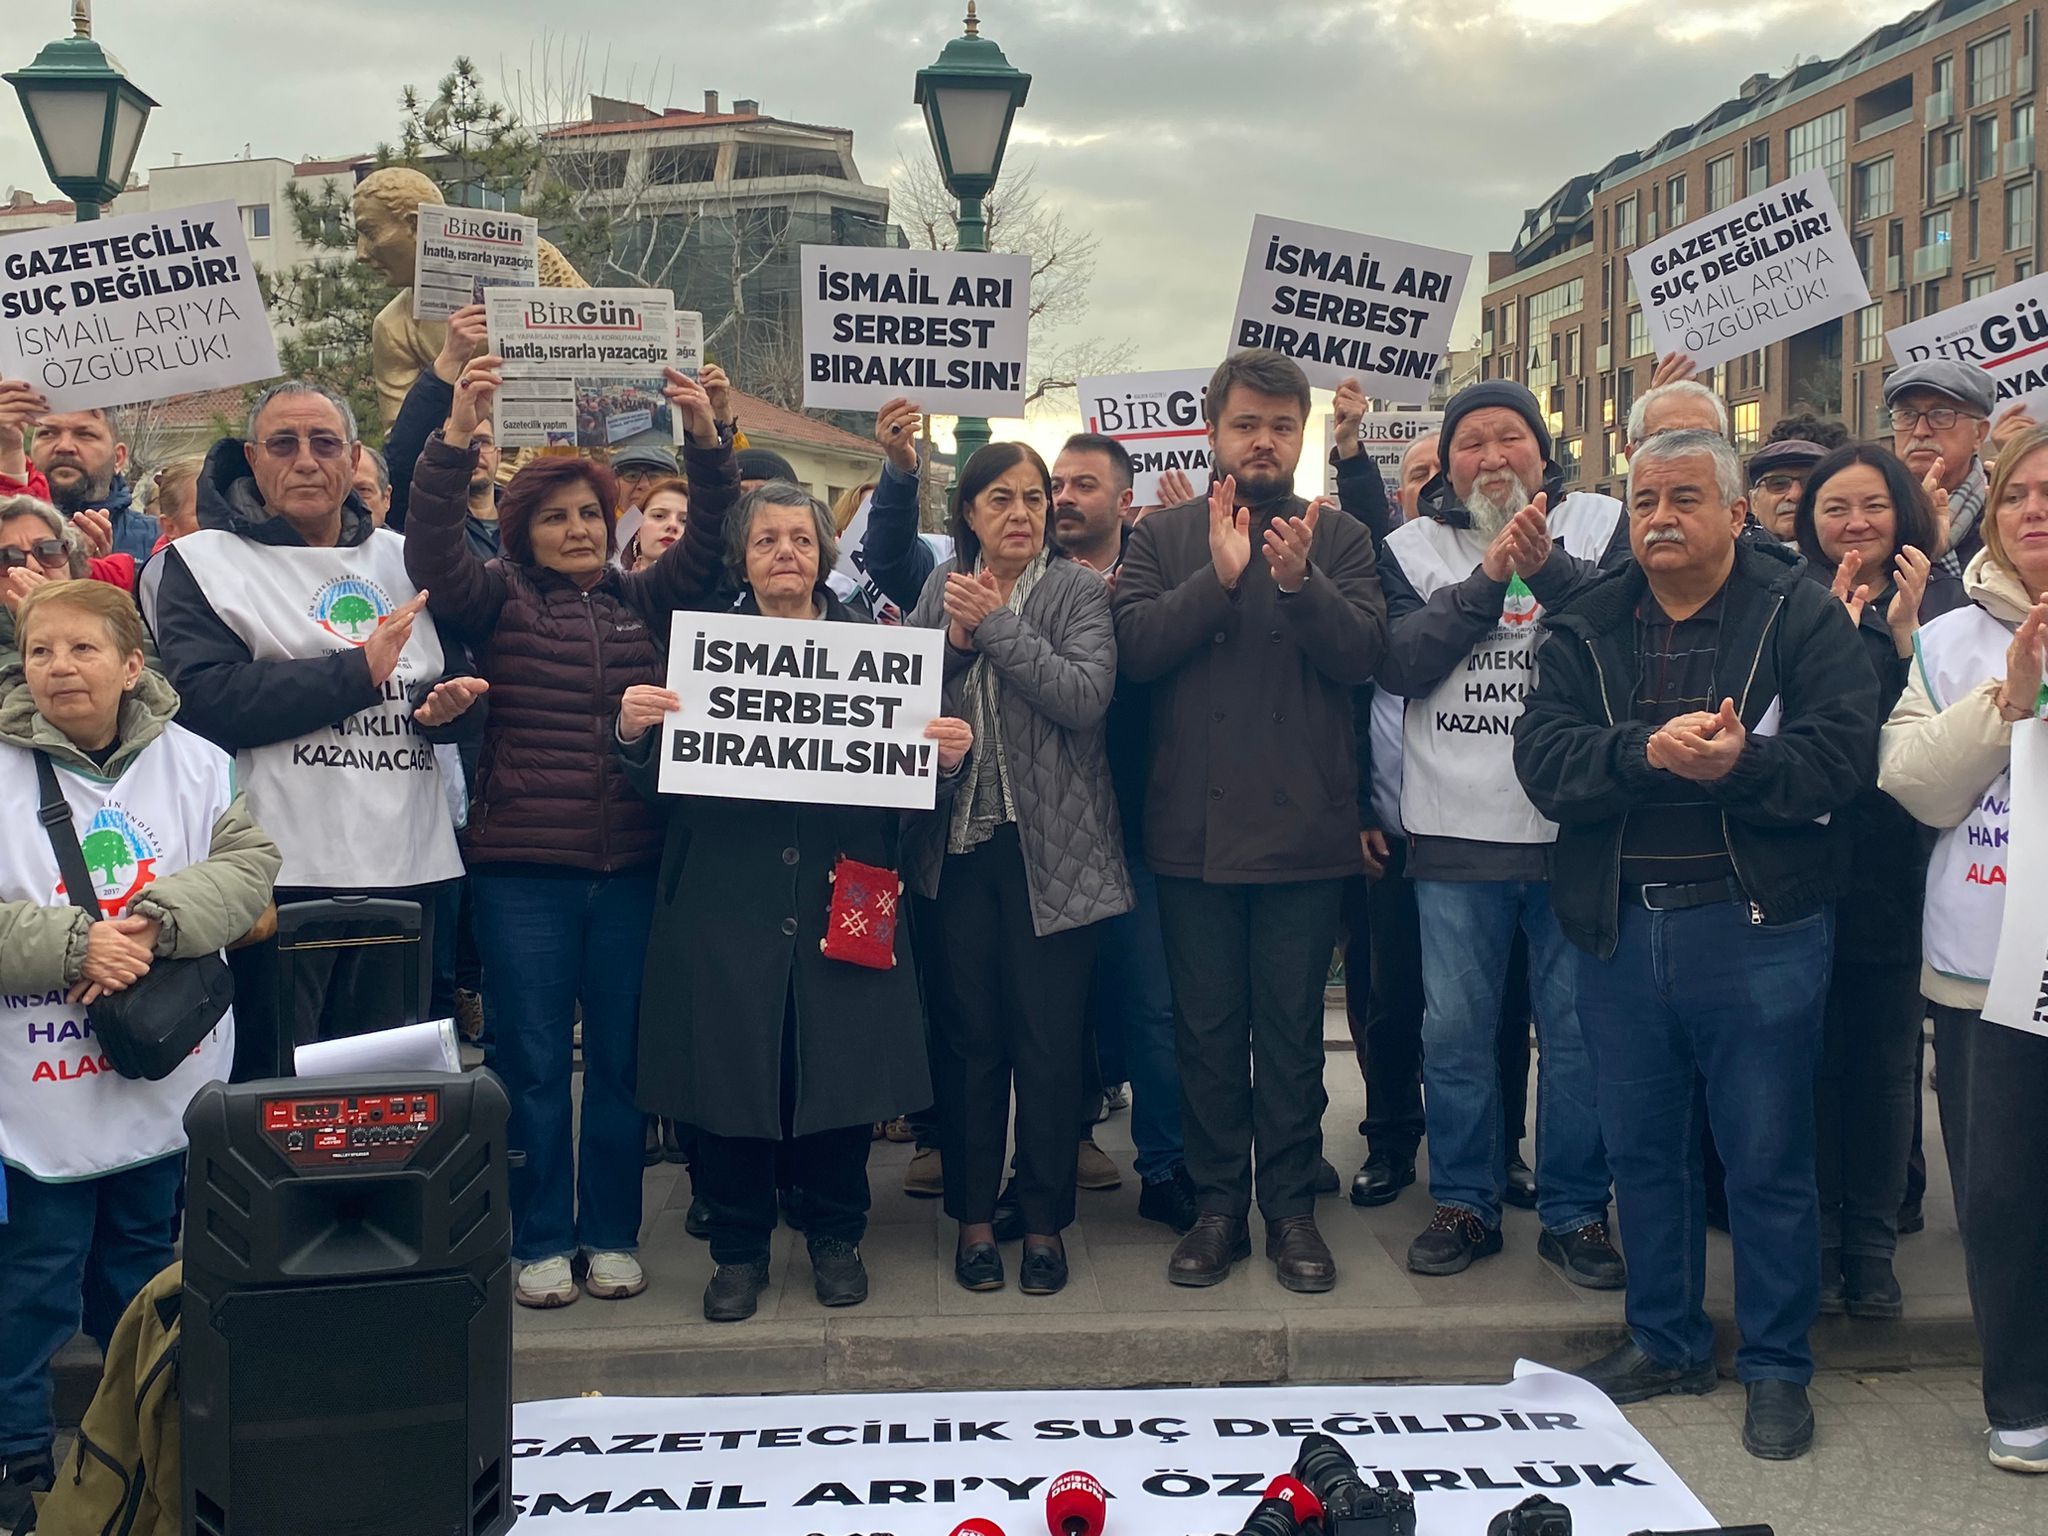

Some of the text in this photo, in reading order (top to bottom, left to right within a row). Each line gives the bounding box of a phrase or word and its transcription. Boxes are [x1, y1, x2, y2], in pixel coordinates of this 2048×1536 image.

[5, 219, 221, 281] GAZETECİLİK
[1651, 188, 1814, 276] GAZETECİLİK
[1265, 235, 1452, 303] İSMAİL ARI
[1650, 212, 1832, 307] SUÇ DEĞİLDİR!
[3, 256, 241, 319] SUÇ DEĞİLDİR!
[819, 264, 1012, 308] İSMAİL ARI
[1662, 284, 1745, 333] İSMAİL
[15, 313, 125, 357] İSMAİL
[832, 313, 995, 349] SERBEST
[1271, 286, 1429, 339] SERBEST
[1685, 278, 1830, 352] ÖZGÜRLÜK!
[42, 334, 231, 389] ÖZGÜRLÜK!
[500, 339, 668, 363] İnatla, ısrarla yazacağız
[810, 353, 1021, 391] BIRAKILSIN!
[1238, 319, 1439, 381] BIRAKILSIN!
[692, 631, 923, 686] İSMAİL ARI
[706, 686, 902, 729] SERBEST
[672, 729, 931, 778] BIRAKILSIN!
[103, 888, 120, 896] 2017
[512, 1409, 1585, 1458] GAZETECİLİK SUÇ DEĞİLDİR
[792, 1476, 1117, 1507] ARI'Y
[1051, 1482, 1102, 1502] DURUM
